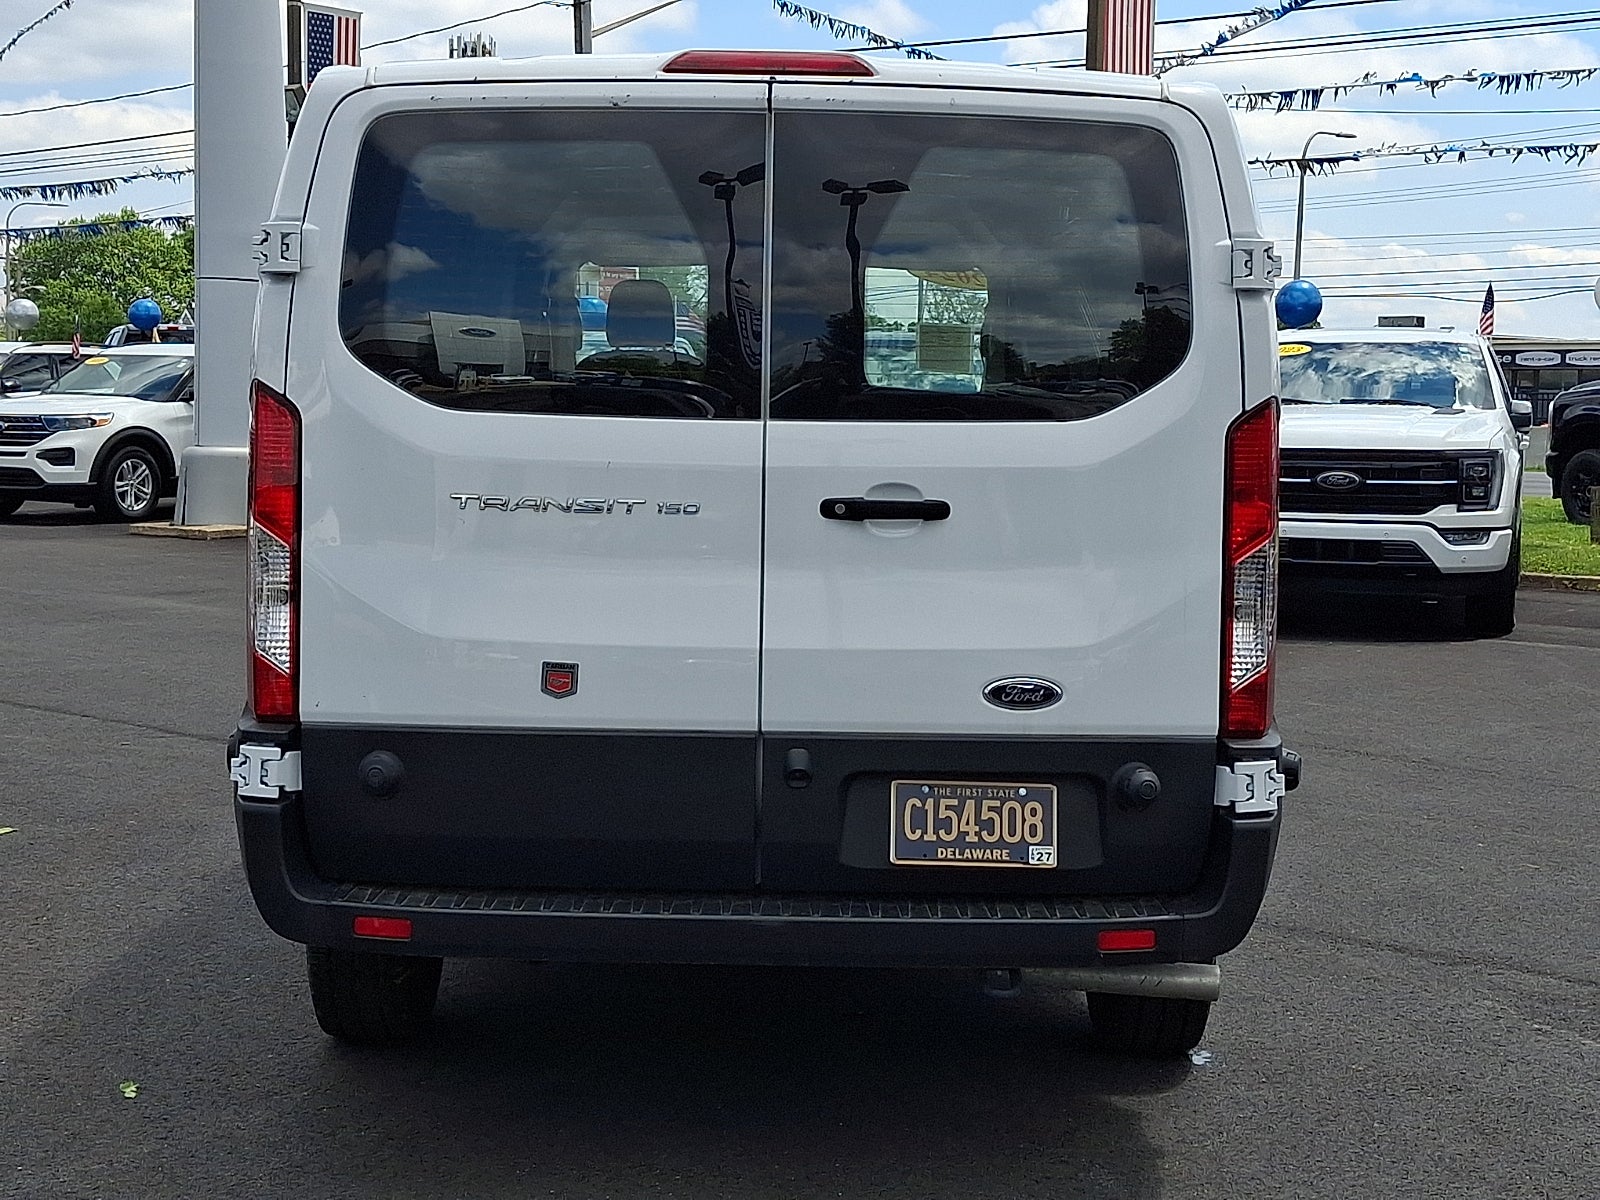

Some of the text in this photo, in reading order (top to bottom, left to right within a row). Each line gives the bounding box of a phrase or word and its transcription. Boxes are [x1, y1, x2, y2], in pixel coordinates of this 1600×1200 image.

[450, 493, 701, 515] TRANSIT 150
[1002, 684, 1045, 702] Ford
[934, 787, 1015, 798] THE FIRST STATE
[904, 797, 1044, 844] C154508
[937, 847, 1010, 860] DELAWARE
[1036, 851, 1053, 862] 27
